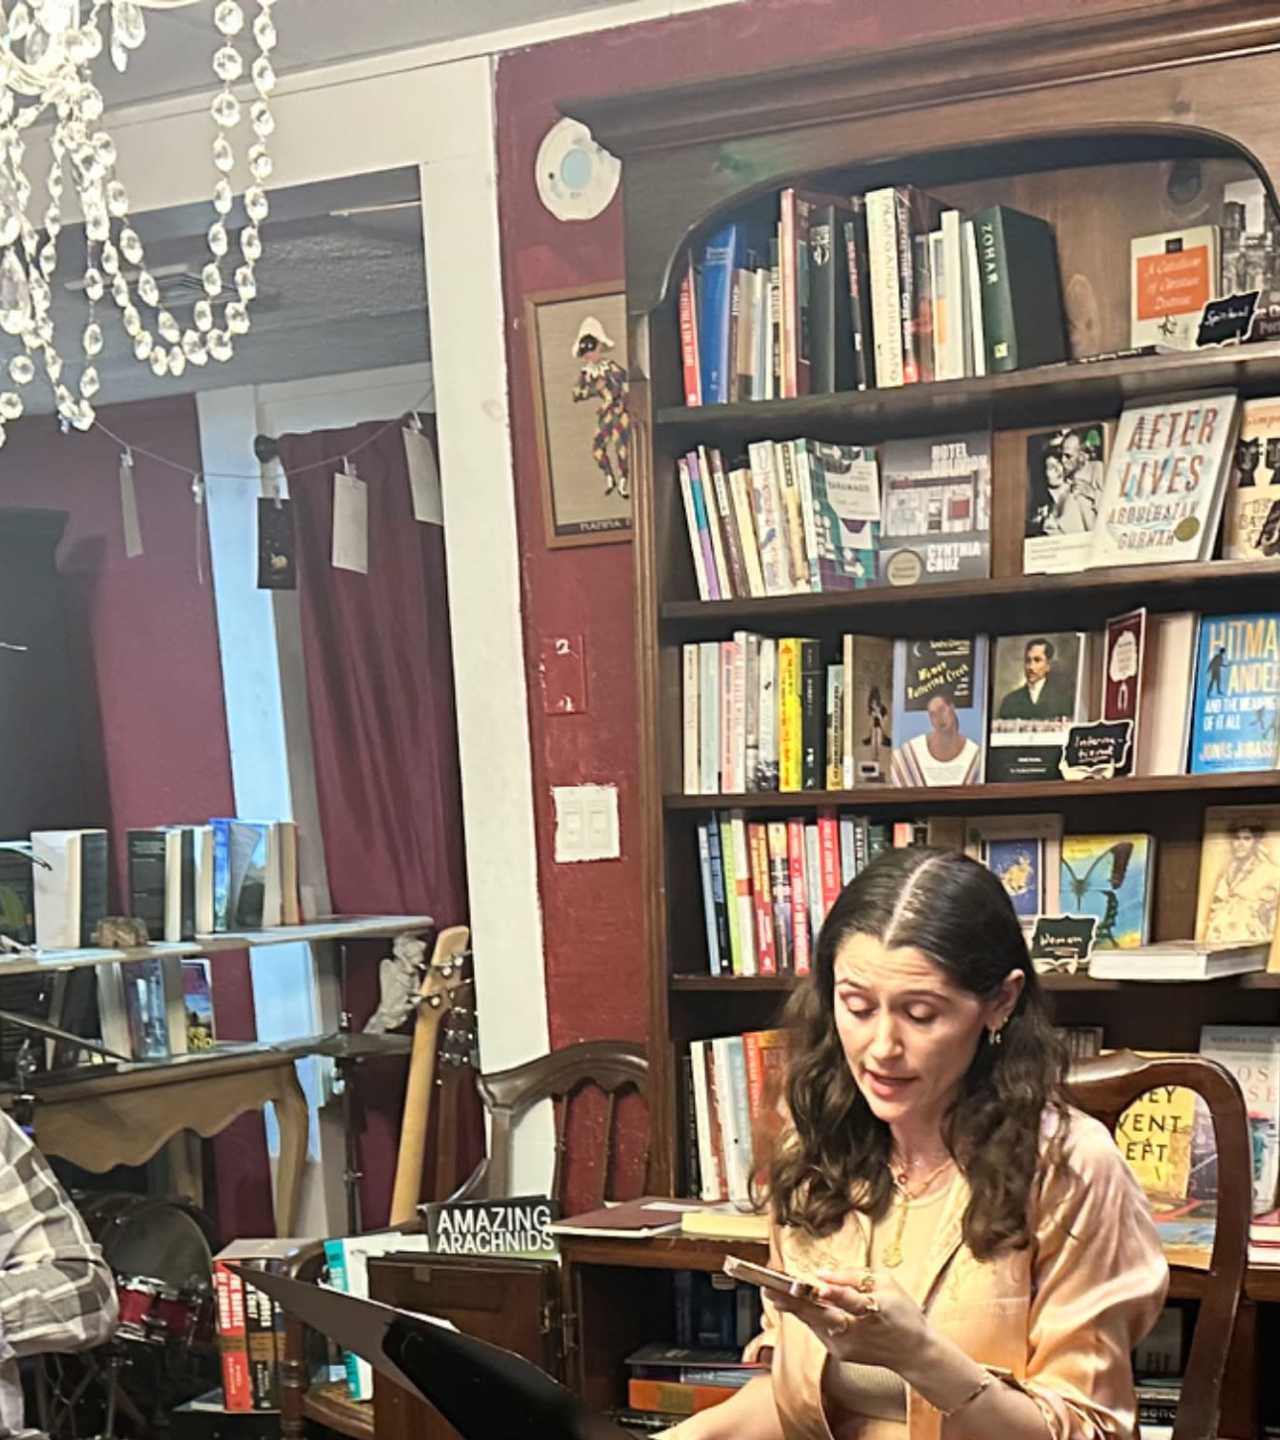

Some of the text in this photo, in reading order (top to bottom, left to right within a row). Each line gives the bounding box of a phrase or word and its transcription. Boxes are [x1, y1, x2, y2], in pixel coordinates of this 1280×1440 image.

[981, 222, 999, 285] ZOHAR
[1127, 408, 1219, 452] AFTER
[1119, 455, 1204, 498] LIVES
[436, 1204, 552, 1234] AMAZING
[436, 1231, 555, 1254] ARACHNIDS
